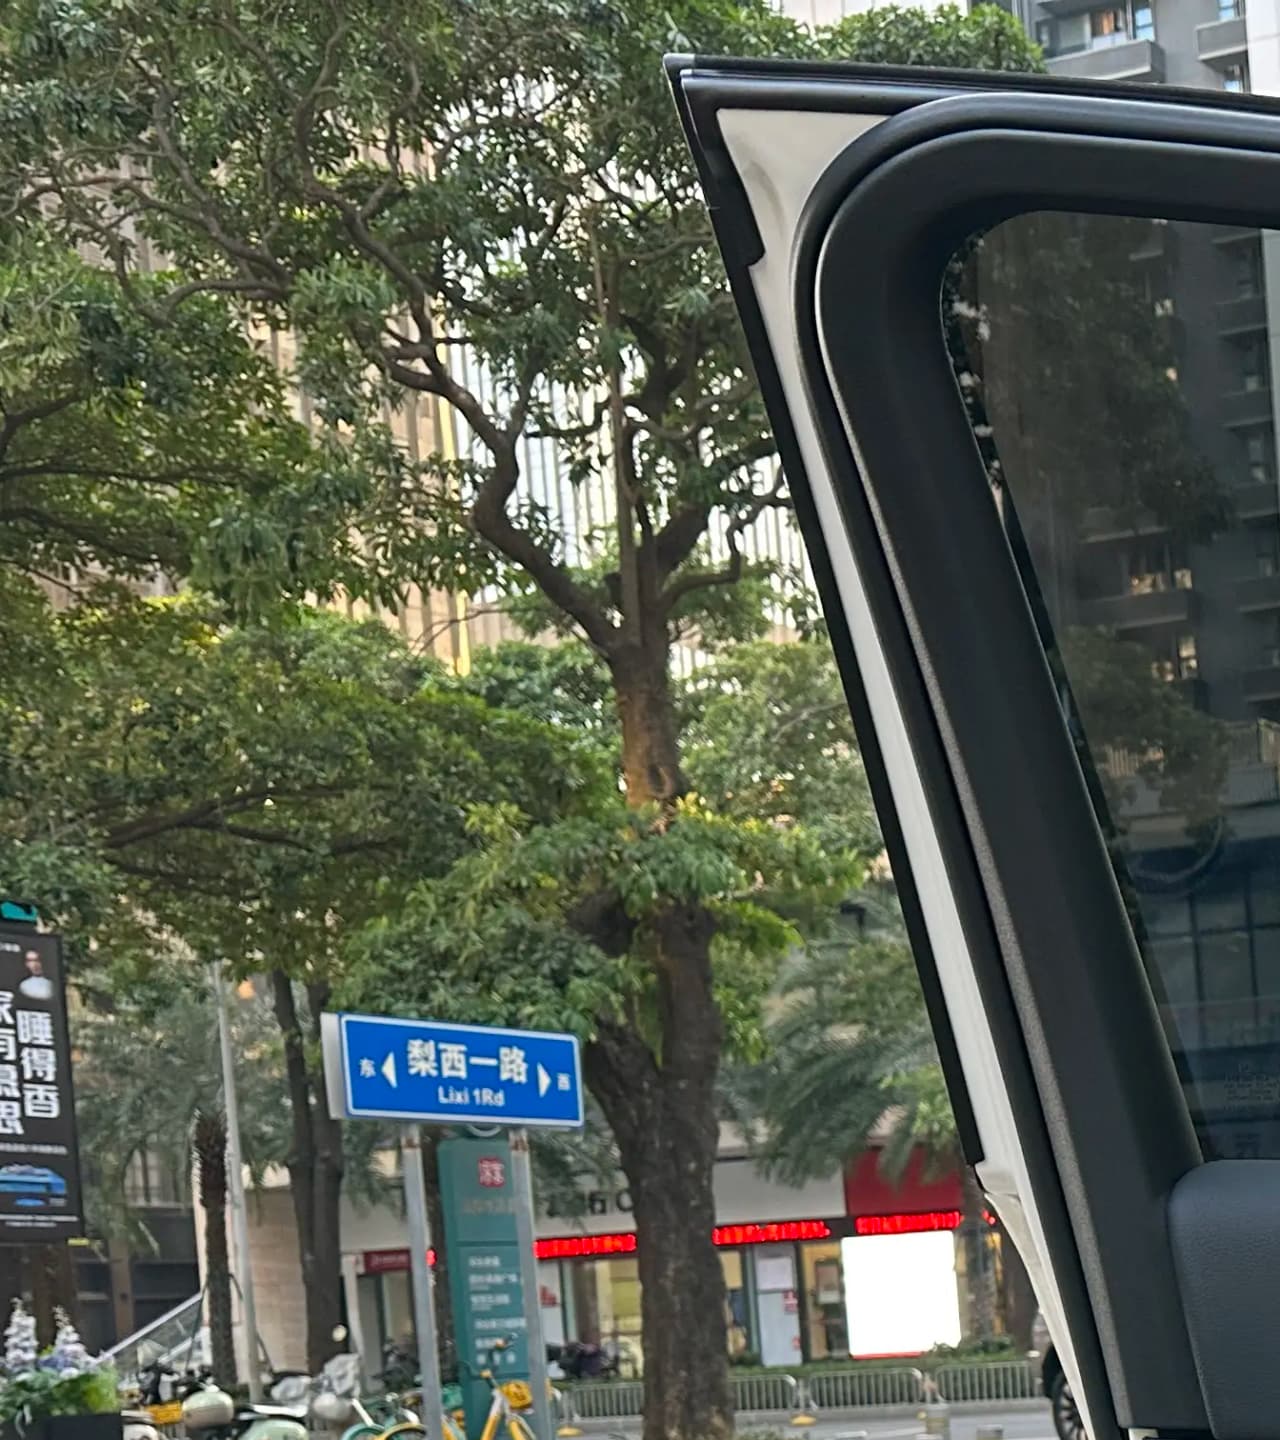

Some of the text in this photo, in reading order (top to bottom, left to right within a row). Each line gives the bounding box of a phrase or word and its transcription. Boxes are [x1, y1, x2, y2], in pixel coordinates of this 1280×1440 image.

[16, 1009, 60, 1118] 睡得香
[359, 1058, 376, 1078] 东
[407, 1039, 528, 1084] 梨西一路
[438, 1086, 505, 1107] Lixi 1Rd
